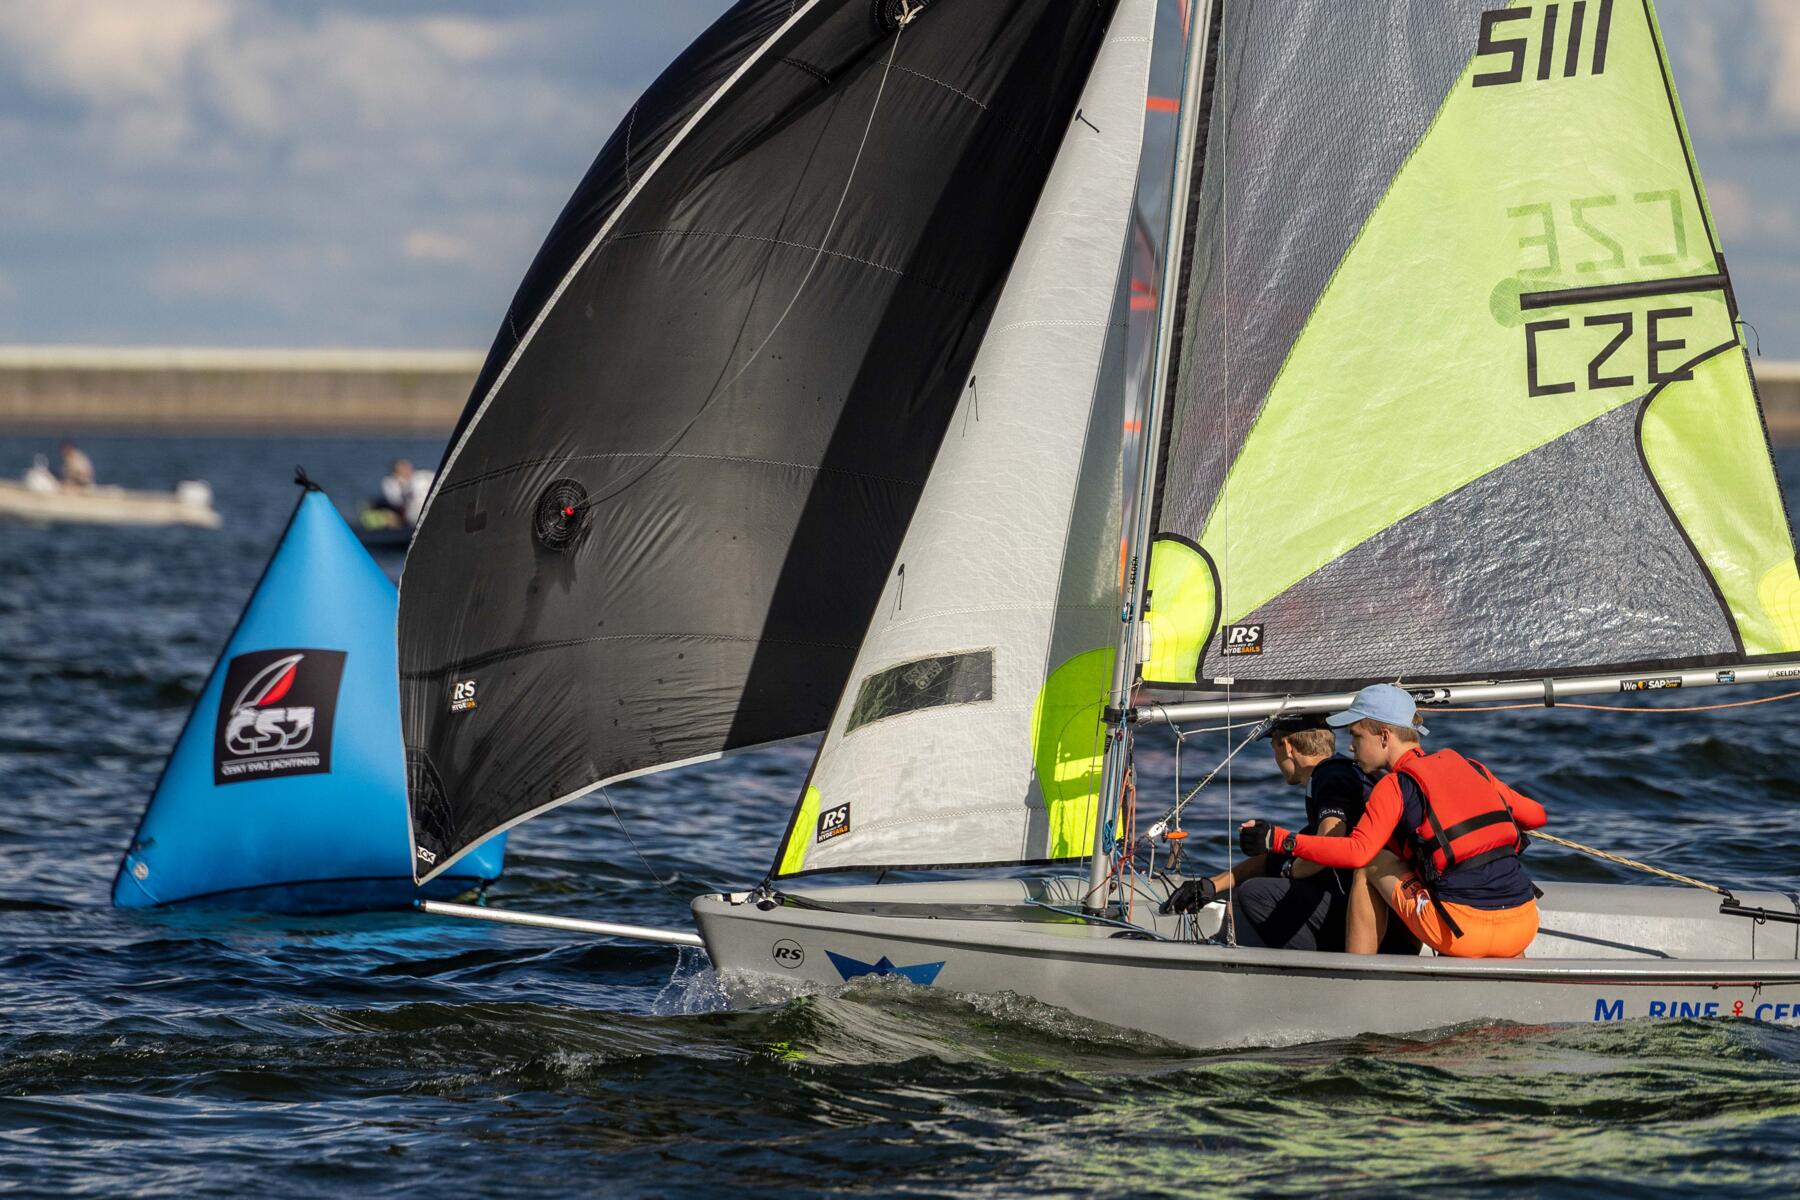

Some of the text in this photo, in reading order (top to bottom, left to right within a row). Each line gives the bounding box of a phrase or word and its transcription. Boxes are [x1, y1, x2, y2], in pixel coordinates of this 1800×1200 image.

[1525, 307, 1693, 397] CZE
[1229, 626, 1260, 644] RS
[1775, 669, 1800, 677] SELDE
[453, 680, 476, 700] RS
[1623, 681, 1637, 691] We
[1649, 680, 1665, 689] SAP
[822, 806, 848, 830] RS
[775, 947, 802, 960] RS
